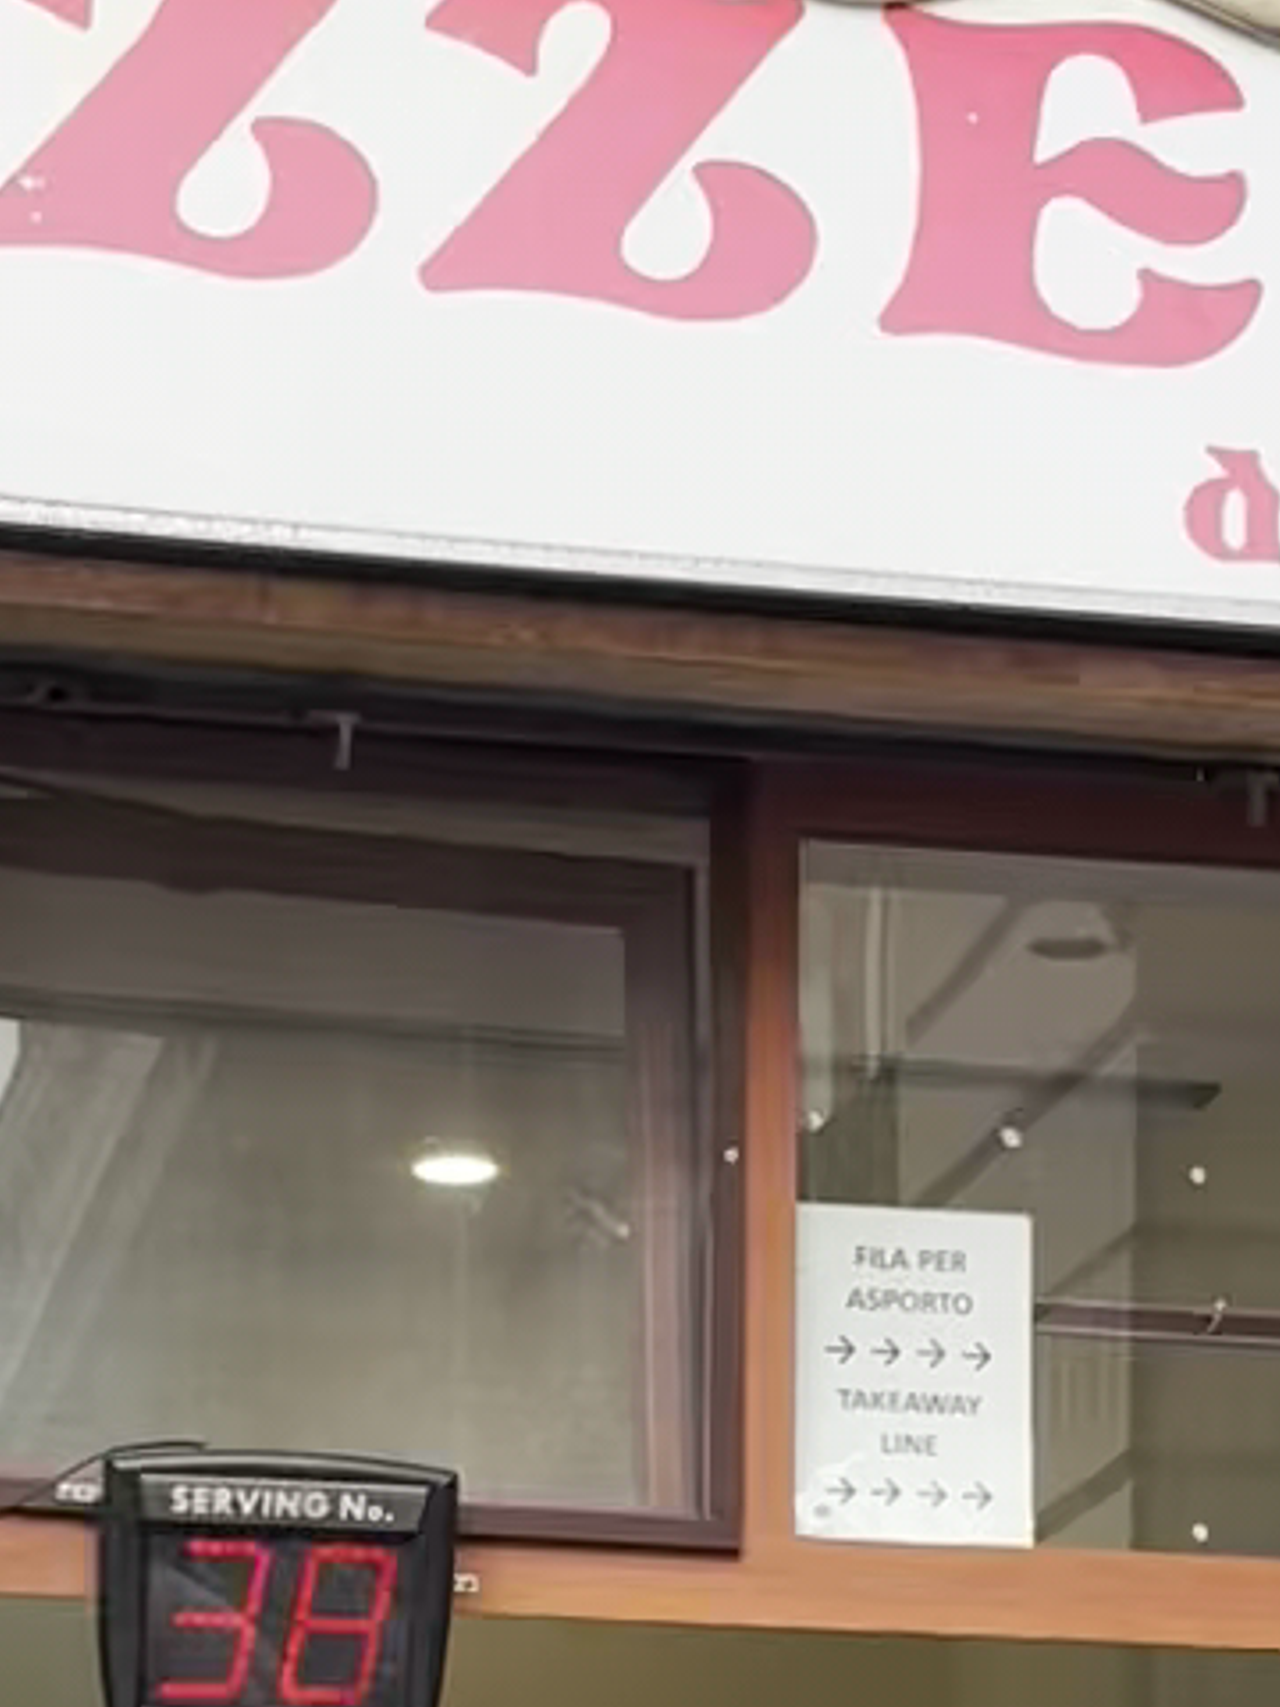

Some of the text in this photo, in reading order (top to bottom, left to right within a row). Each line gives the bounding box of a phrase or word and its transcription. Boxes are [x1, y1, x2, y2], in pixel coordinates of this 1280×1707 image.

[853, 1244, 967, 1274] FILA PER
[844, 1287, 975, 1317] ASPORTO
[836, 1386, 983, 1417] TAKEAWAY
[880, 1432, 939, 1457] LINE
[168, 1483, 396, 1524] SERVING No.
[153, 1538, 401, 1707] 38
